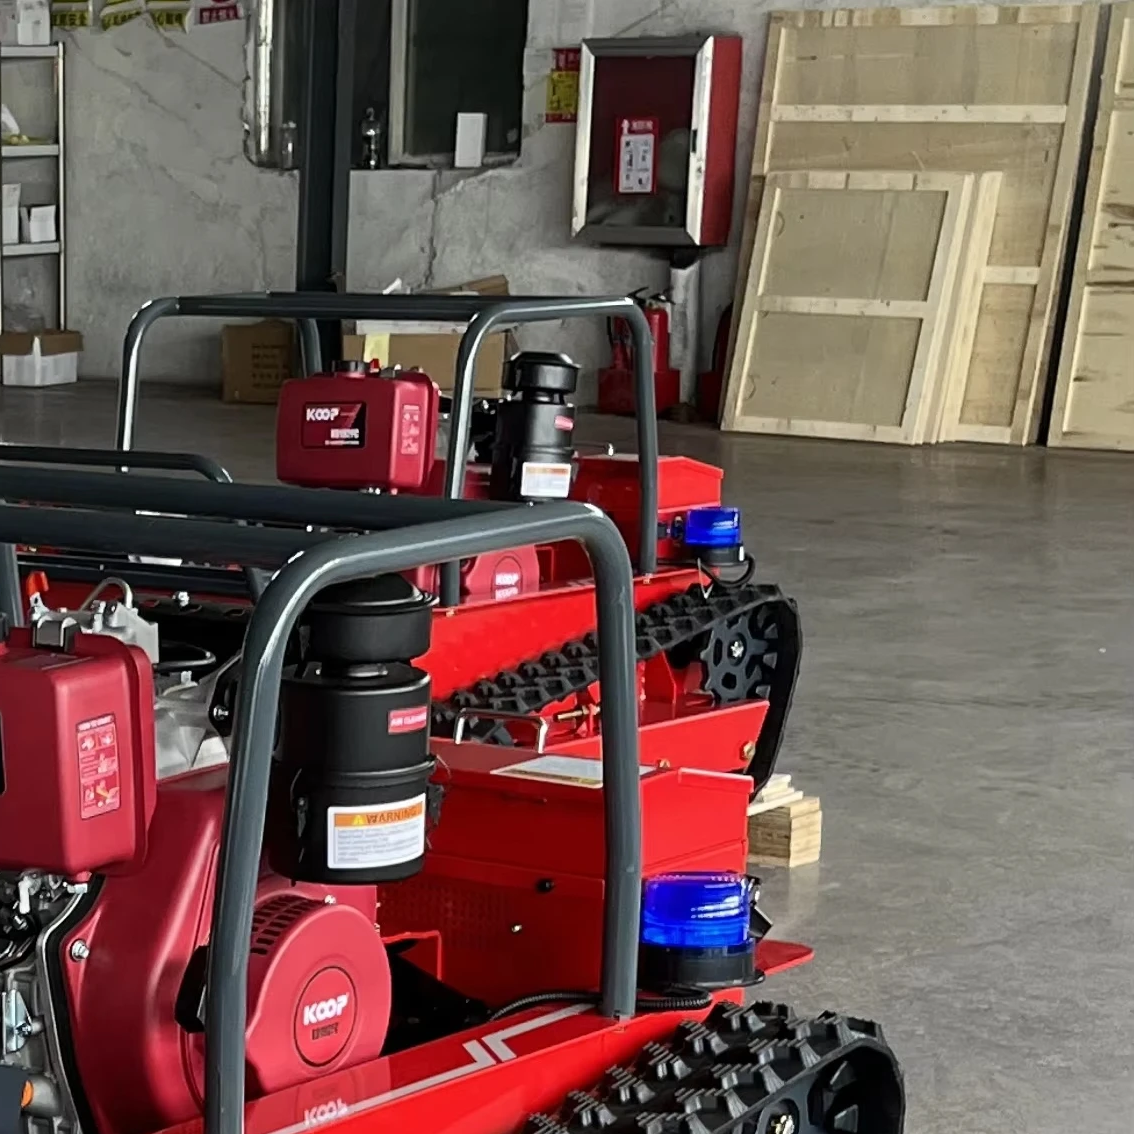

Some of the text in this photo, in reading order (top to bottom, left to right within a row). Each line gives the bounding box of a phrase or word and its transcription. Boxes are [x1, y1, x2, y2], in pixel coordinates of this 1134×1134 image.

[306, 407, 340, 421] KOOP
[366, 806, 417, 824] WARNING
[303, 993, 348, 1026] KOOP
